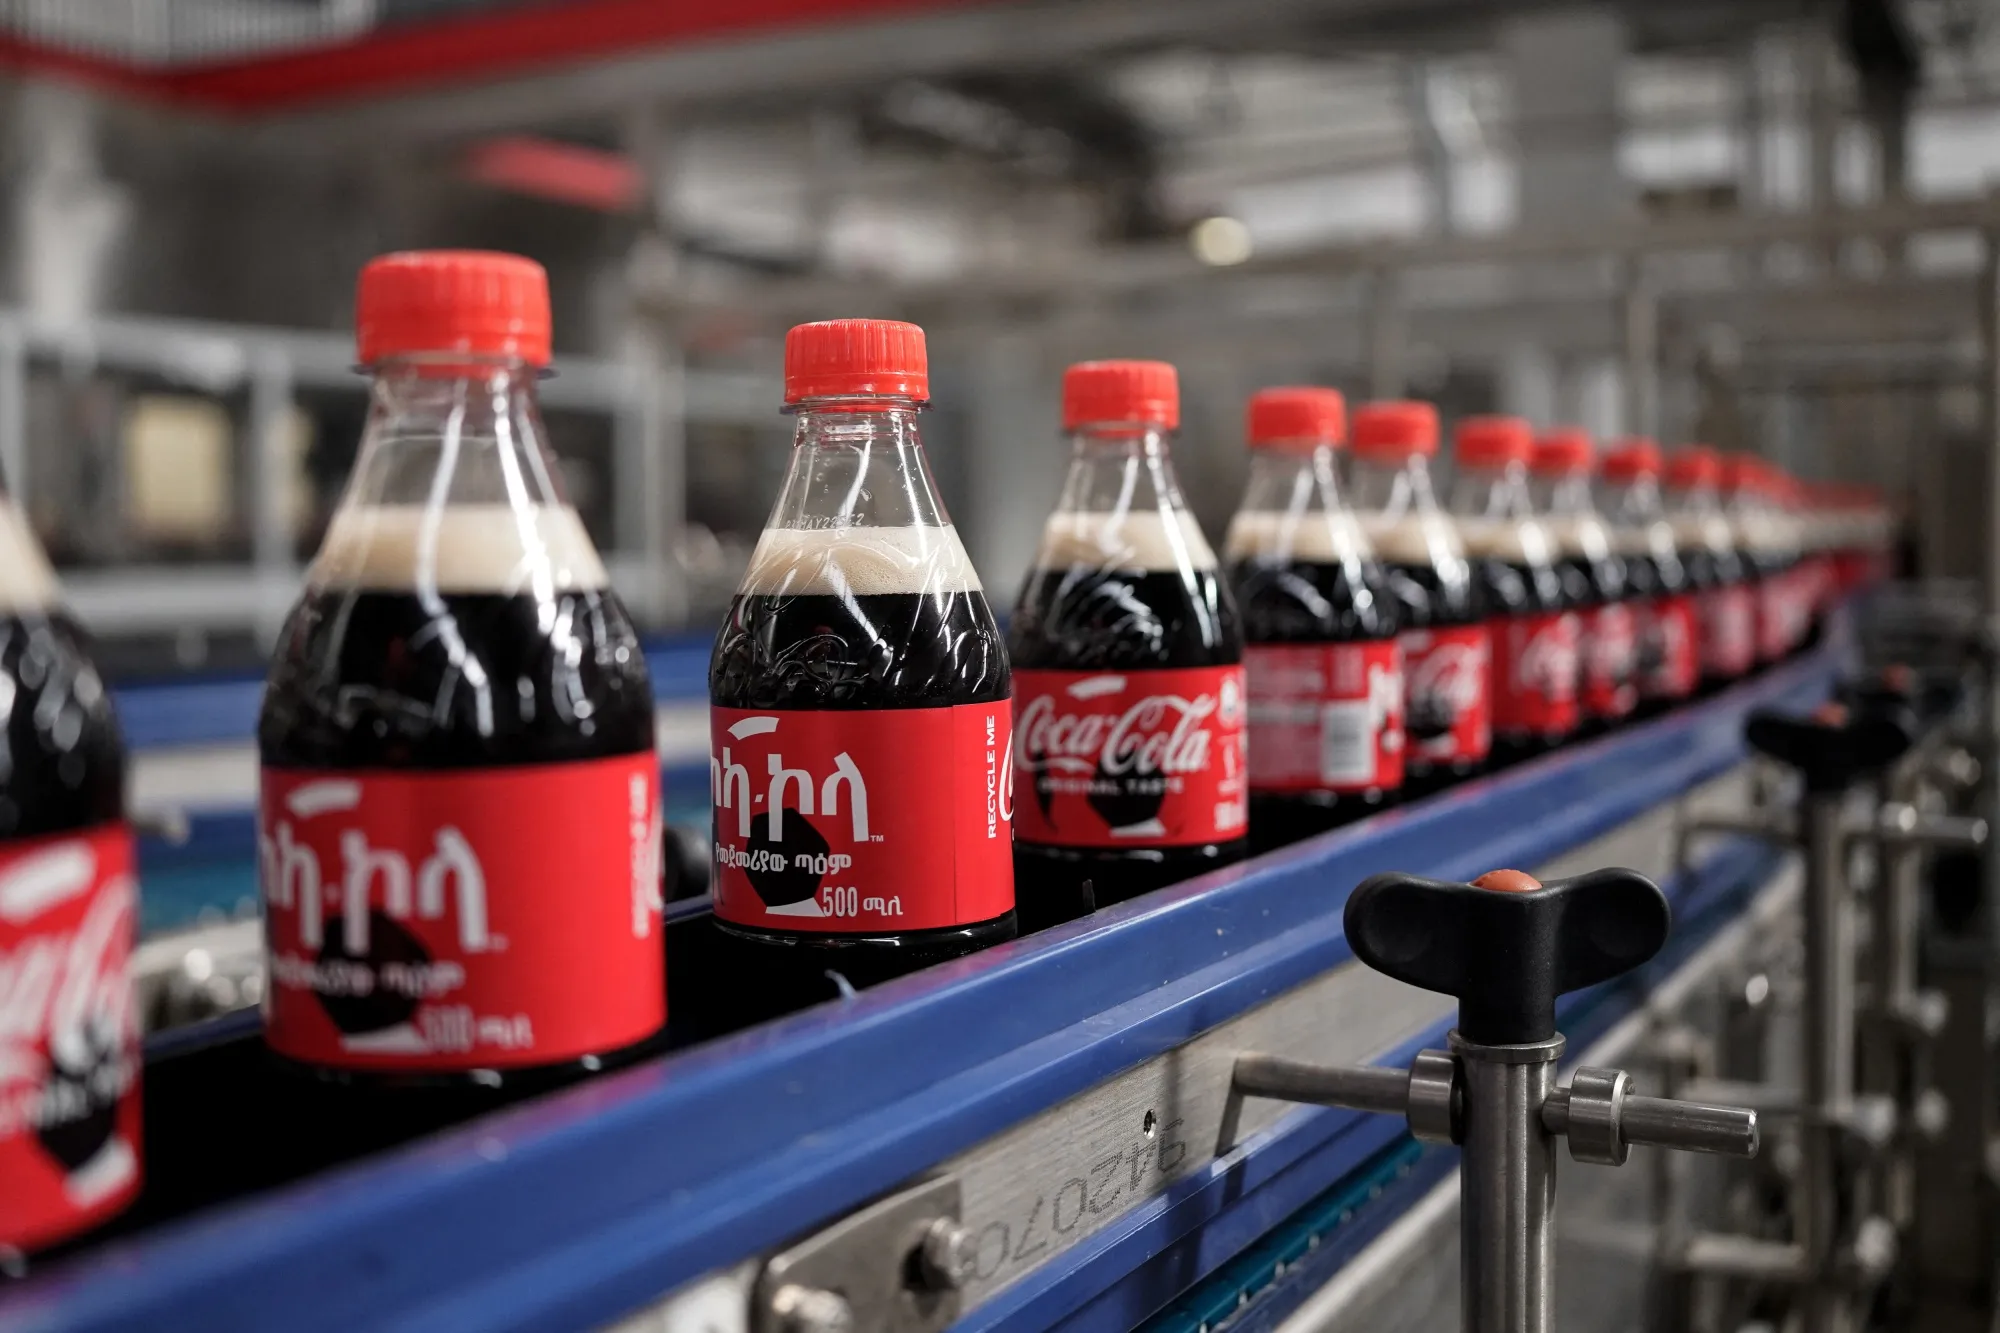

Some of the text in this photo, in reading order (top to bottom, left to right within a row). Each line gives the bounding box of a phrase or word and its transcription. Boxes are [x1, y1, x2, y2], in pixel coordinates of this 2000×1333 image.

[986, 715, 997, 839] RECYCLE ME
[870, 834, 884, 842] TM
[822, 886, 858, 917] 500
